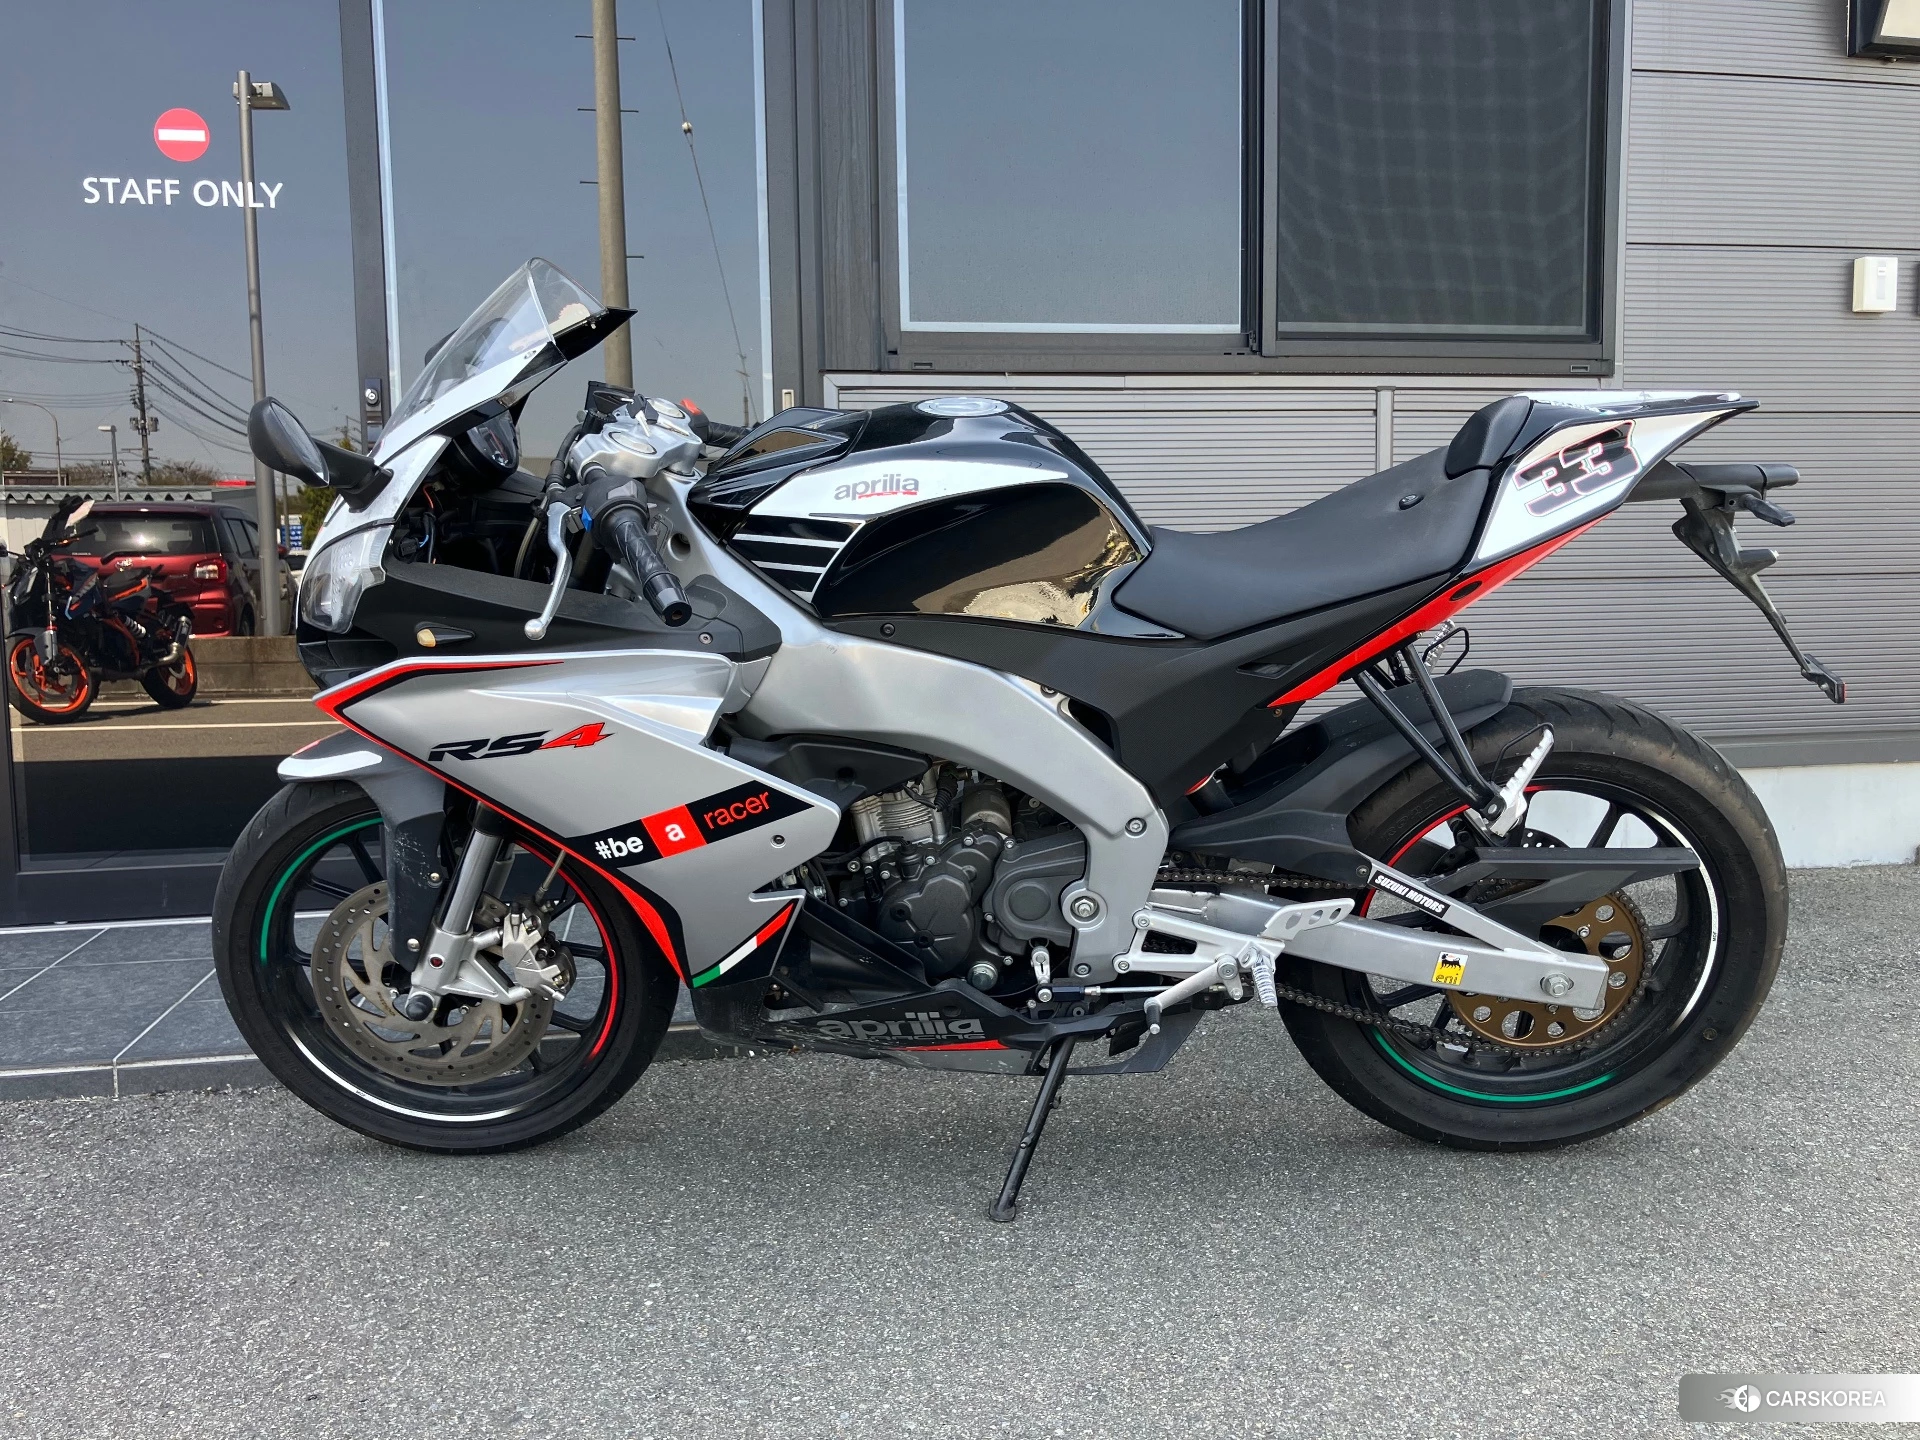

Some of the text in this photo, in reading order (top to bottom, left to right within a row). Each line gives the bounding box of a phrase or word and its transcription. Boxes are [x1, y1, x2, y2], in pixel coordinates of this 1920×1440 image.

[82, 177, 283, 208] STAFF ONLY
[1512, 419, 1643, 517] 33
[834, 474, 919, 501] aprilia
[428, 722, 615, 761] RS4
[595, 791, 770, 859] #be a racer
[1374, 875, 1445, 913] SUZUKI MOTORS
[1435, 973, 1458, 985] eni
[816, 1011, 984, 1040] aprilia
